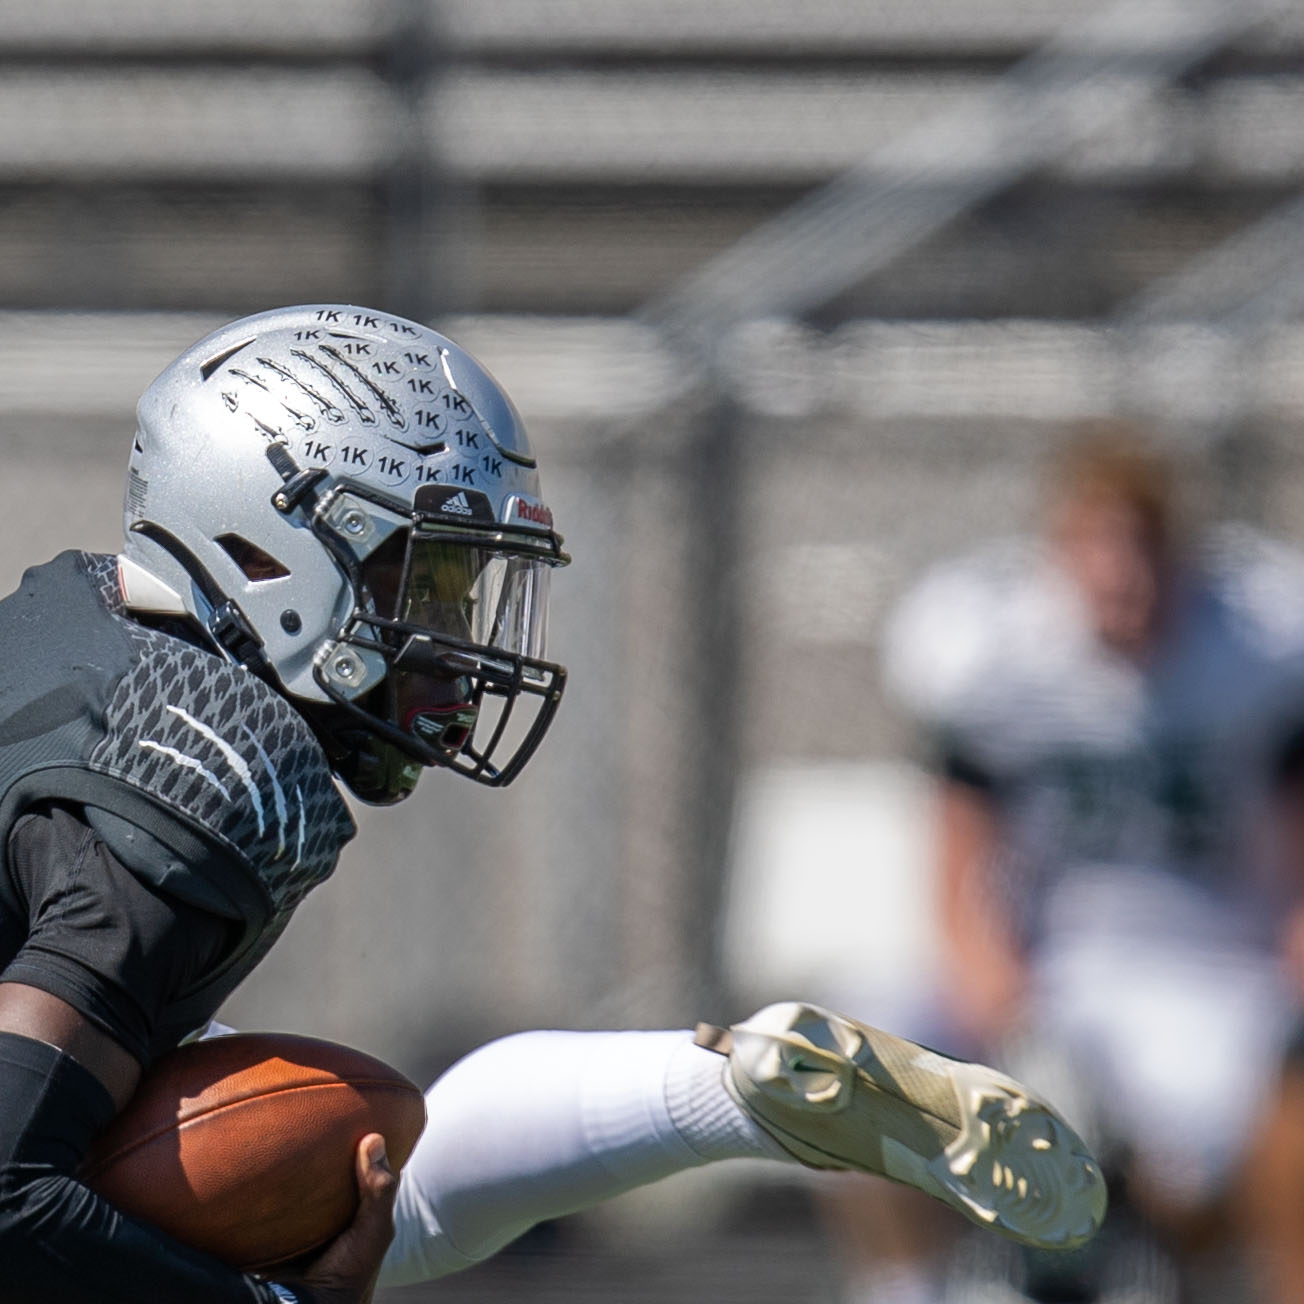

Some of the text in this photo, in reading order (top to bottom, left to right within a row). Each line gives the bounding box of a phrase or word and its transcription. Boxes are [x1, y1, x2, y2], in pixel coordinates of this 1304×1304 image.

[316, 310, 342, 322] 1K
[353, 315, 379, 328] 1K
[294, 330, 320, 341] 1K
[390, 323, 416, 335] 1K
[344, 343, 370, 355] 1K
[372, 361, 400, 374] 1K
[404, 352, 431, 367] 1K
[407, 378, 434, 394] 1K
[442, 394, 467, 414] 1K
[415, 409, 440, 430] 1K
[455, 429, 479, 449] 1K
[305, 440, 331, 462] 1K
[341, 446, 368, 465] 1K
[378, 456, 405, 477] 1K
[415, 465, 441, 481] 1K
[452, 464, 476, 485] 1K
[482, 455, 502, 478] 1K
